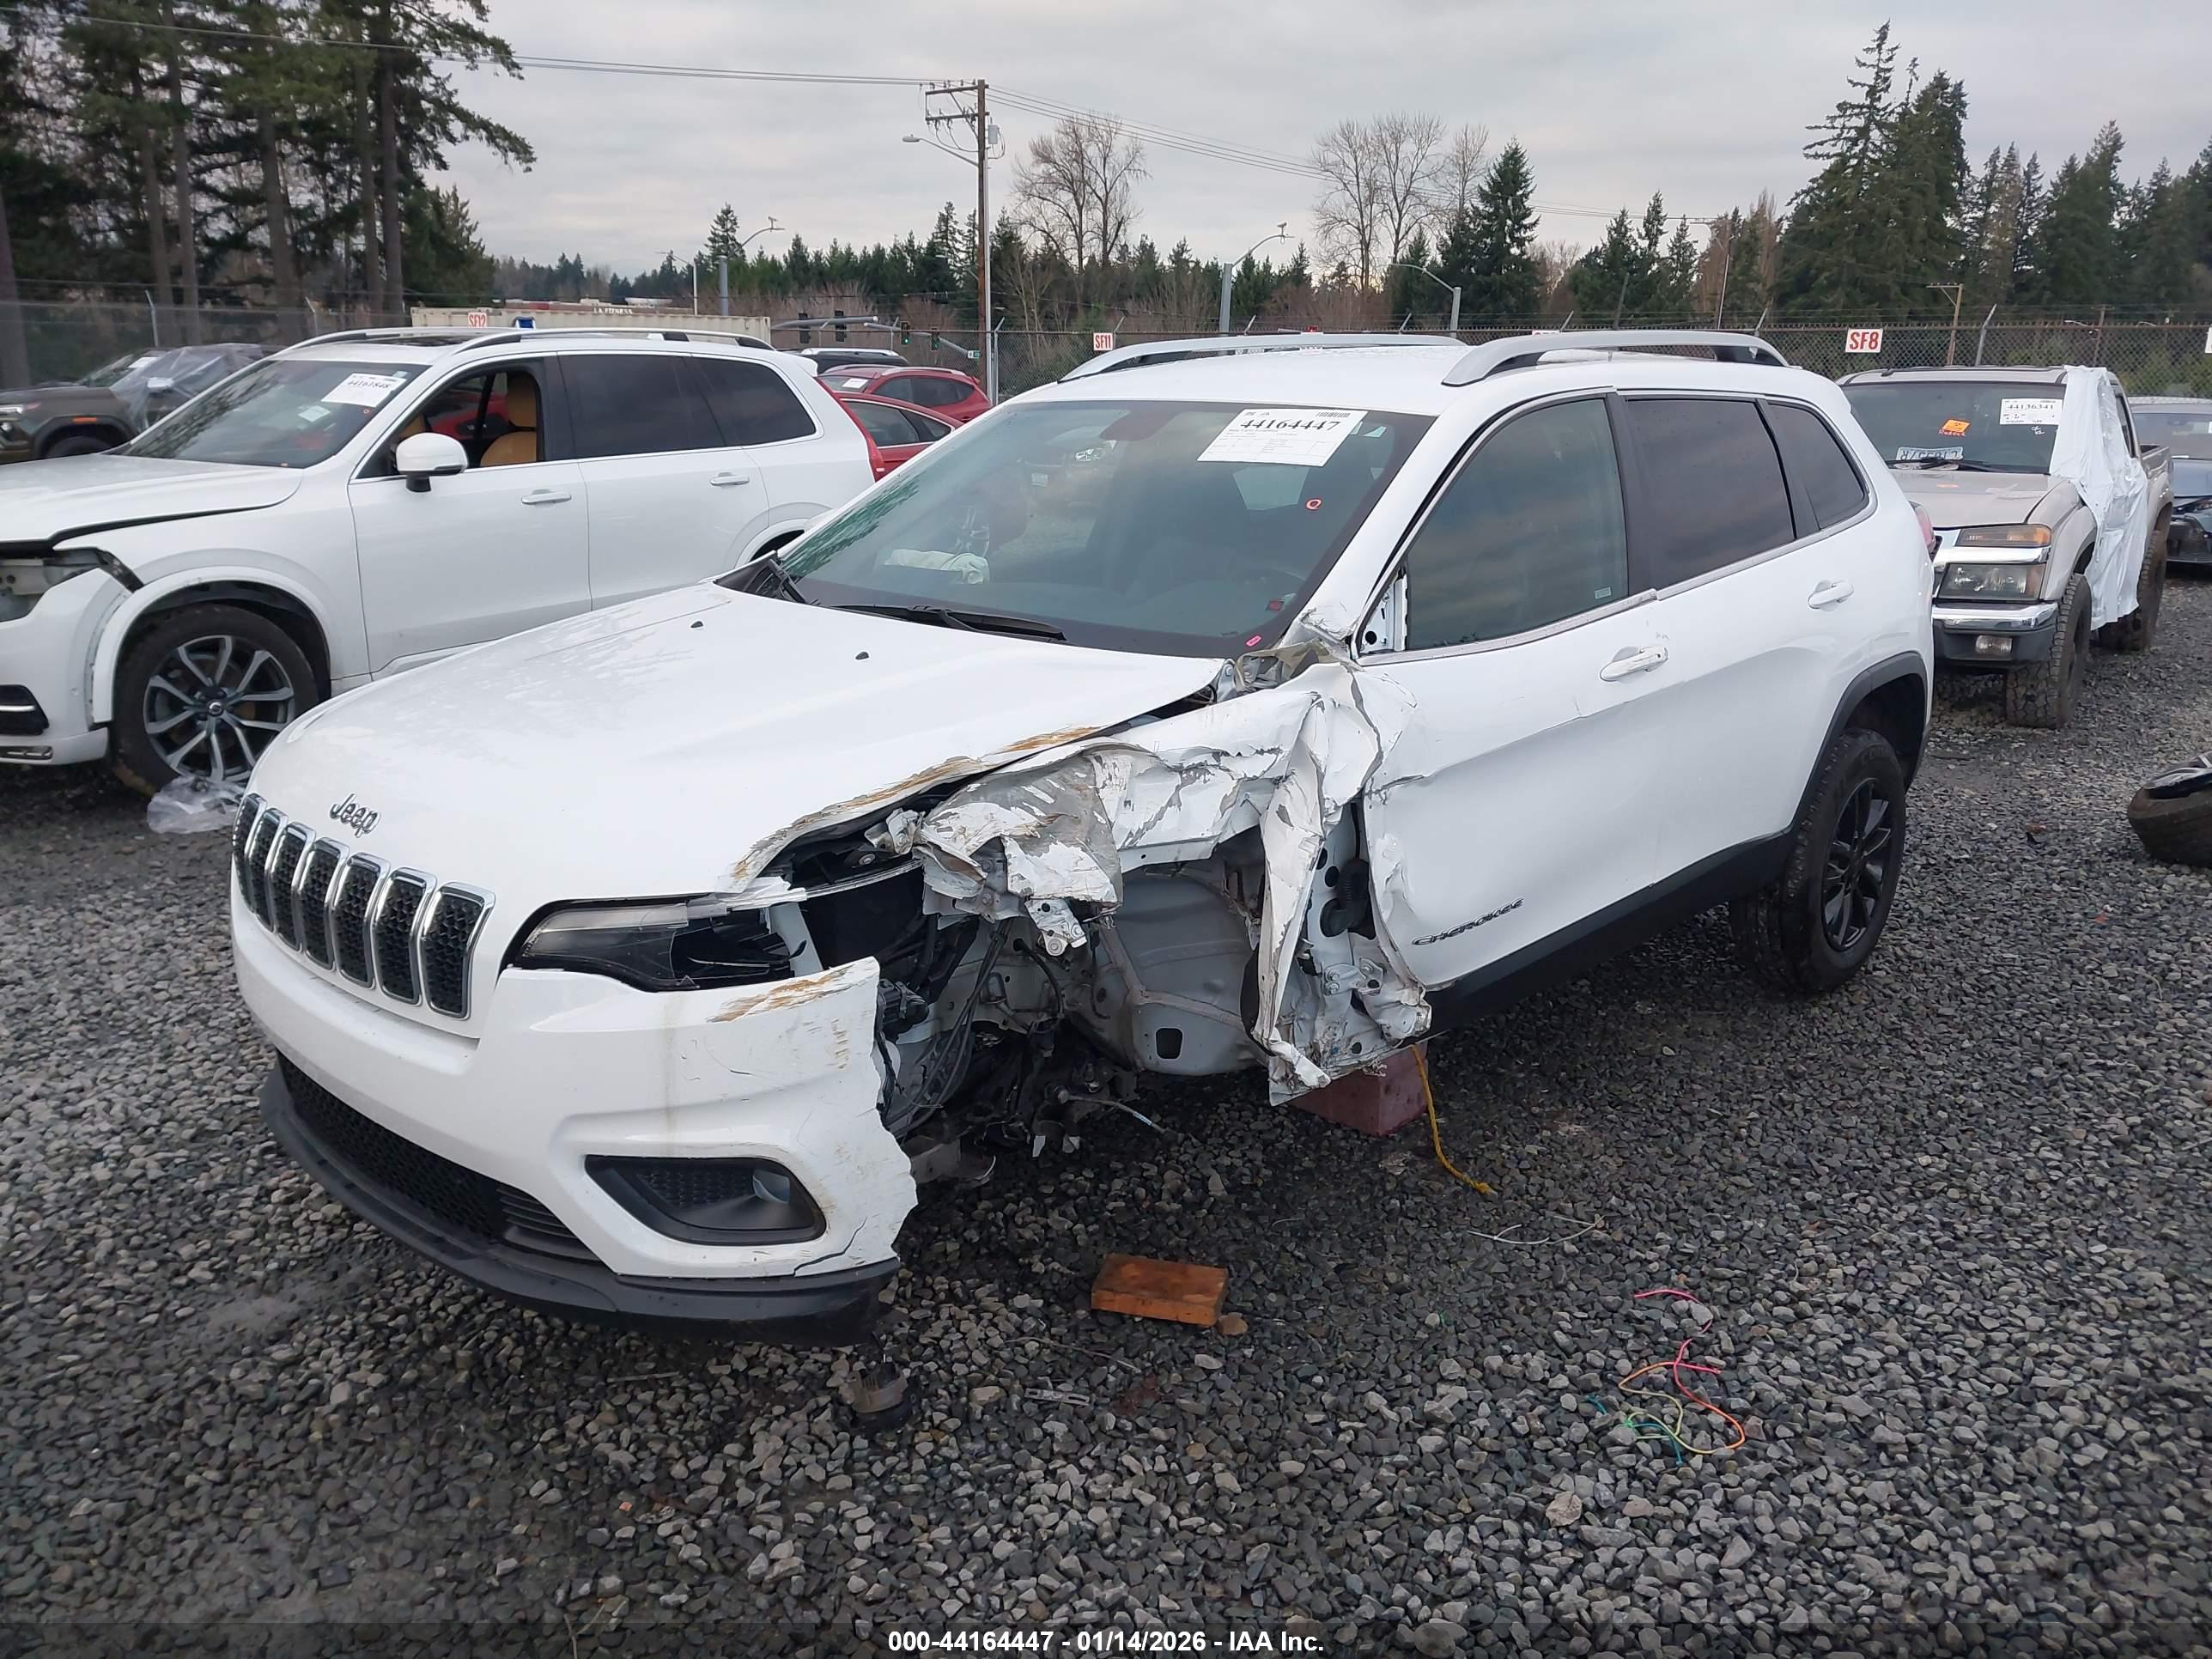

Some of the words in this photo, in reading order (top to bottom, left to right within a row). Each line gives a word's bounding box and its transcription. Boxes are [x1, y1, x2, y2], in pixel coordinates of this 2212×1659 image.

[1095, 334, 1111, 349] SF11
[1849, 331, 1879, 350] SF8
[1240, 418, 1342, 431] 44164447
[329, 793, 380, 838] Jeep
